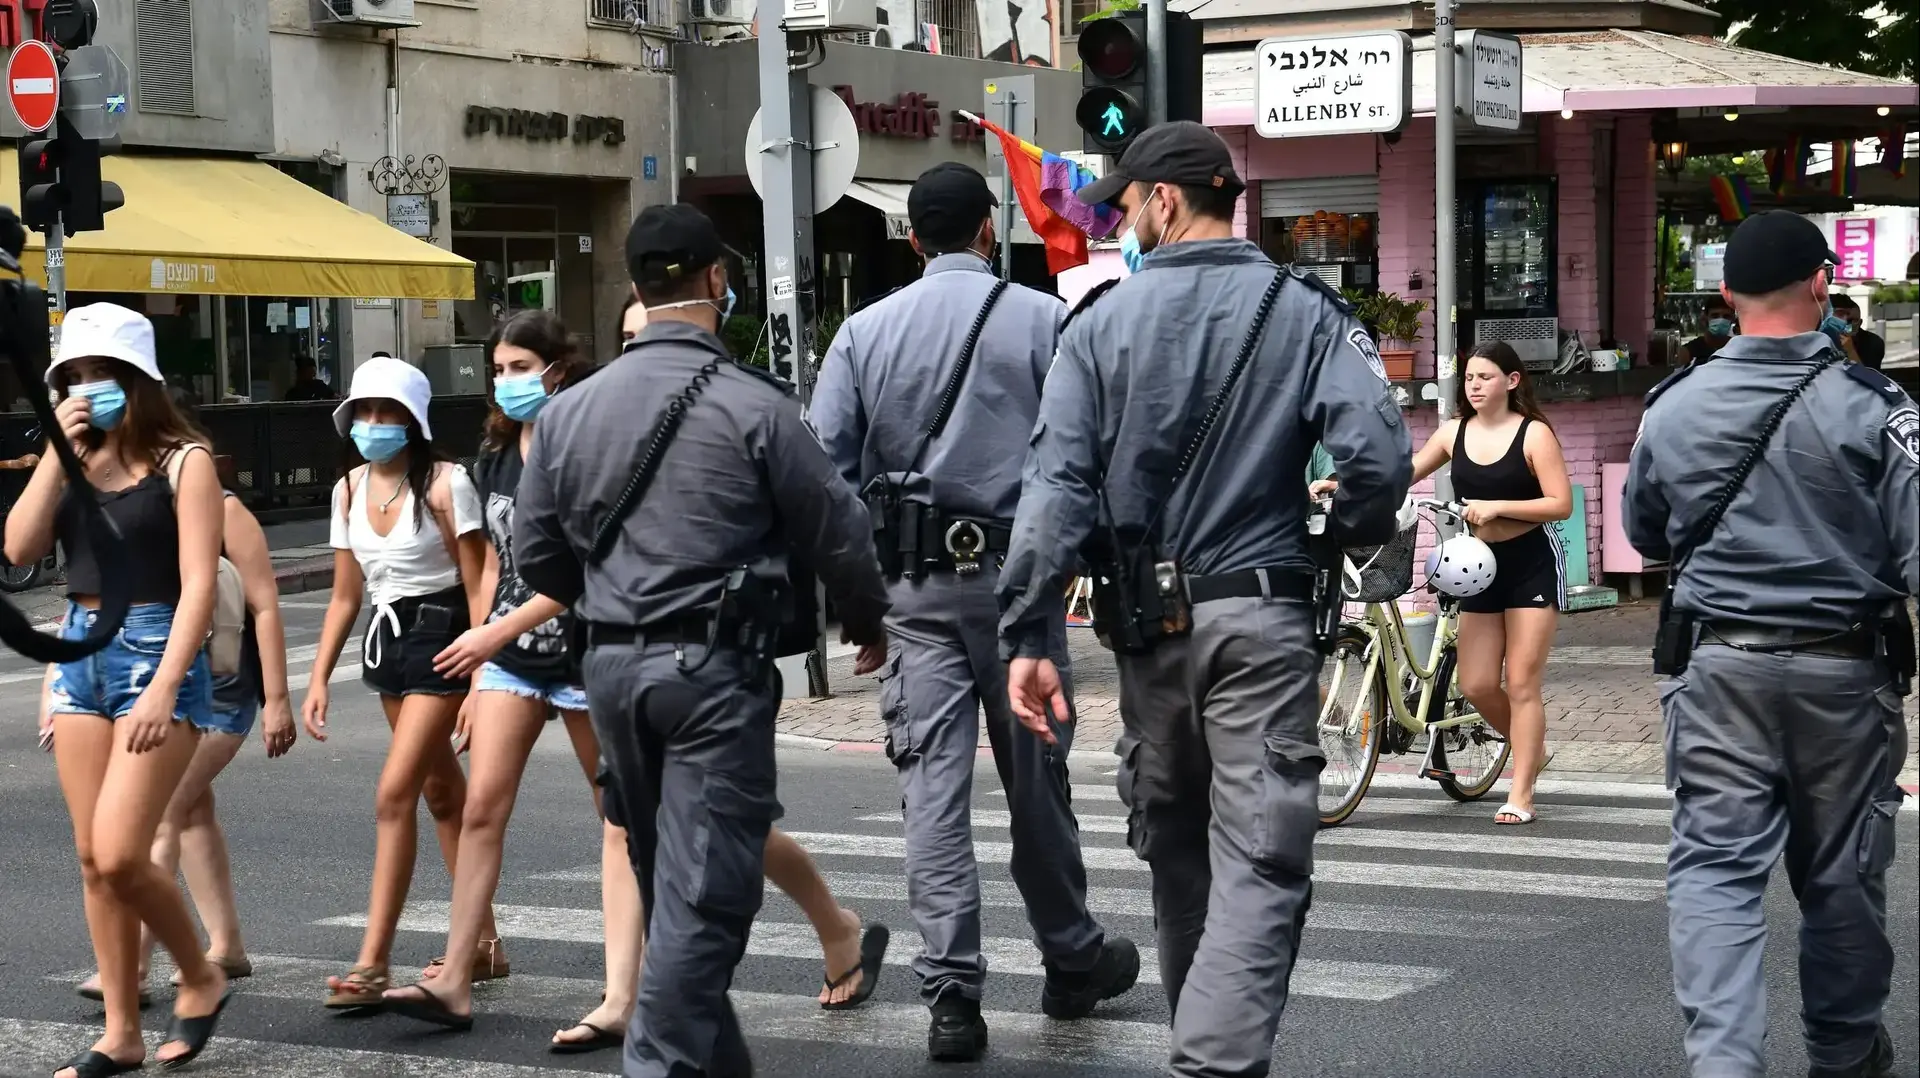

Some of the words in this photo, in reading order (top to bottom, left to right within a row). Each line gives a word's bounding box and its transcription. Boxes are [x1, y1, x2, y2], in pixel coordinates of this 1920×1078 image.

[1267, 45, 1349, 70] אלנבי
[1358, 49, 1390, 65] רח'
[1476, 41, 1502, 64] רוטשילד
[1293, 75, 1326, 97] آلنبي
[1333, 73, 1363, 95] شارع
[1267, 102, 1362, 123] ALLENBY
[1368, 105, 1390, 118] ST.
[1475, 100, 1509, 120] ROTHSCHILD
[645, 160, 654, 176] 31
[894, 219, 913, 237] Ar
[166, 262, 199, 282] העצם
[201, 264, 216, 283] עד
